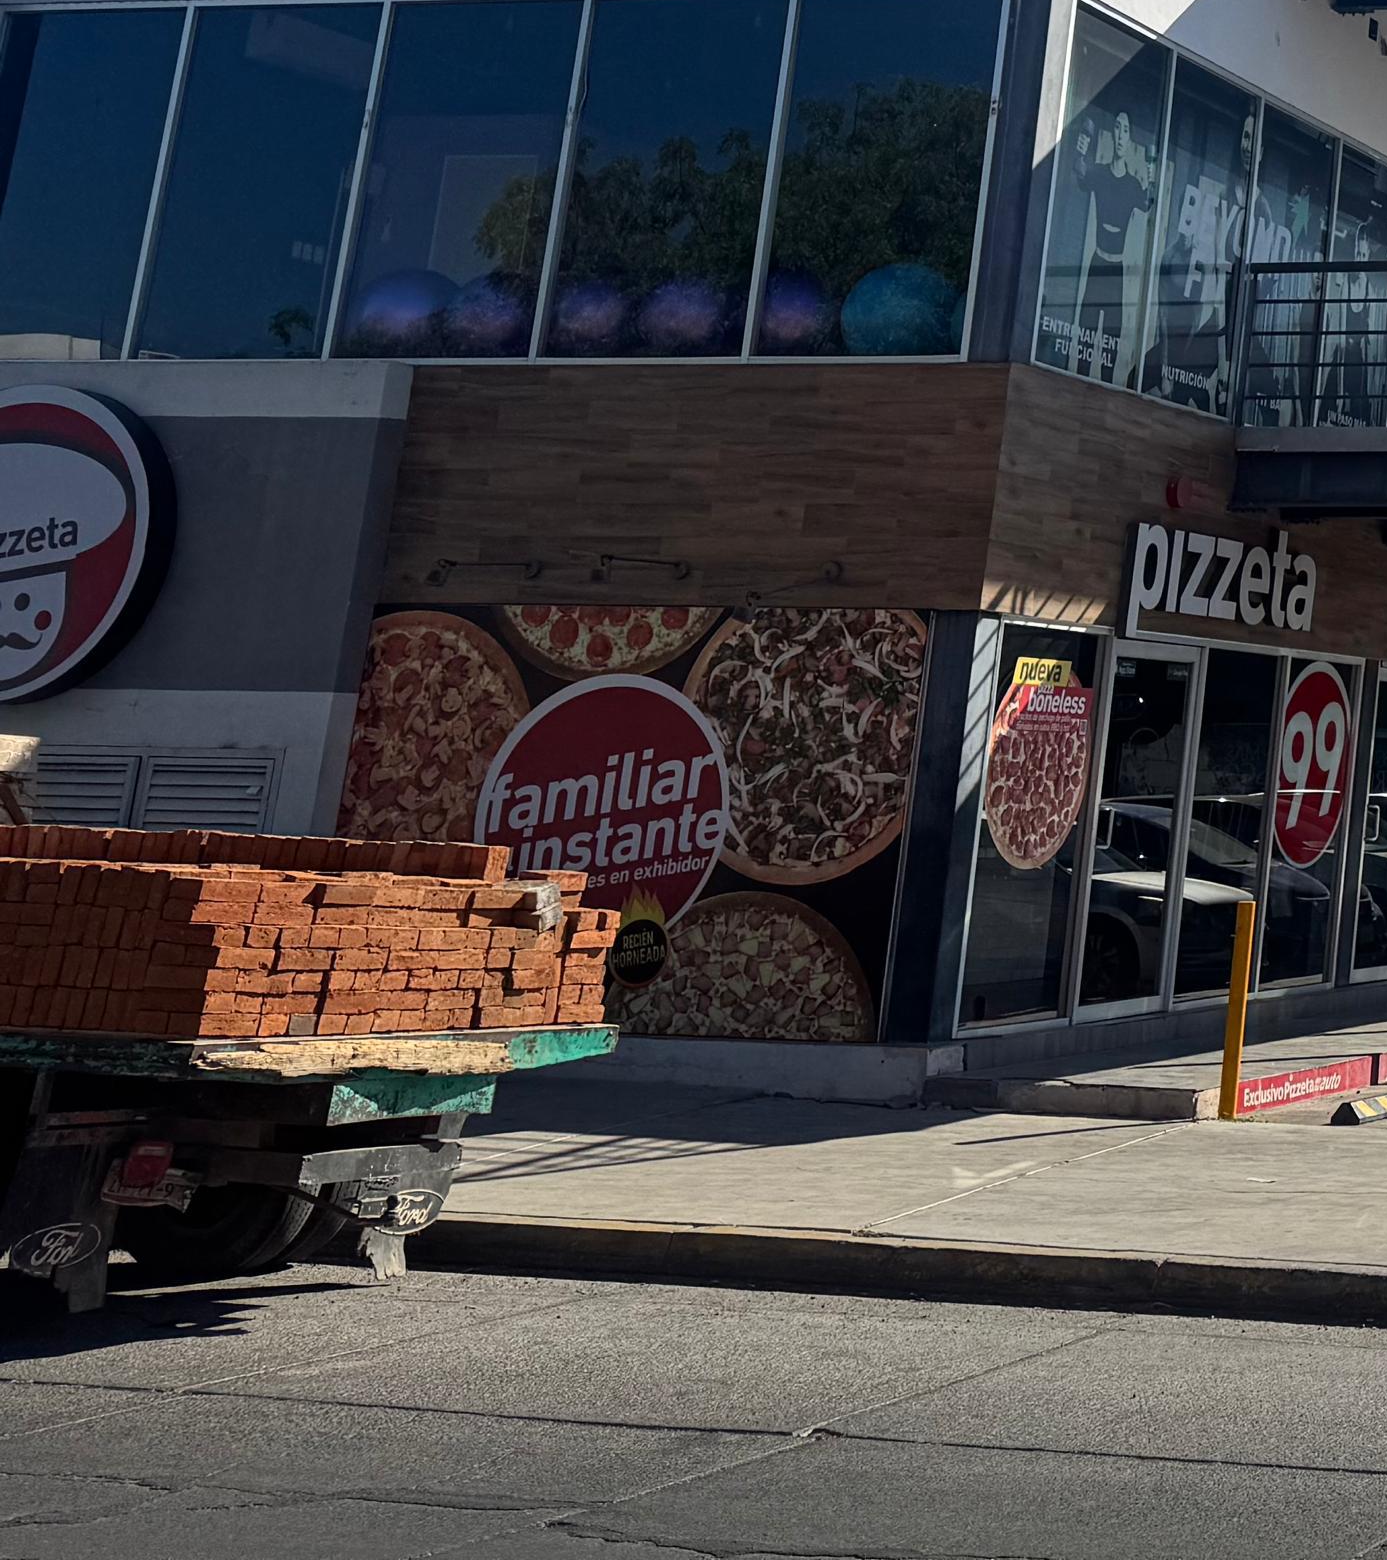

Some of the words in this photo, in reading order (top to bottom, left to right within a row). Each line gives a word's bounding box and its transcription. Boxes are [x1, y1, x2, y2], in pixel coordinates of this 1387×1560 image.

[1126, 522, 1318, 637] pizzeta
[1019, 661, 1063, 683] nueva
[1026, 687, 1087, 715] boneless
[1281, 700, 1346, 832] 99
[487, 748, 718, 834] familiar
[517, 802, 729, 873] instante
[610, 868, 630, 885] en
[633, 854, 709, 881] exhibidor
[611, 944, 667, 969] HORNEADA
[1243, 1083, 1284, 1108] Exclusivo
[1284, 1073, 1314, 1101] Pizzeta
